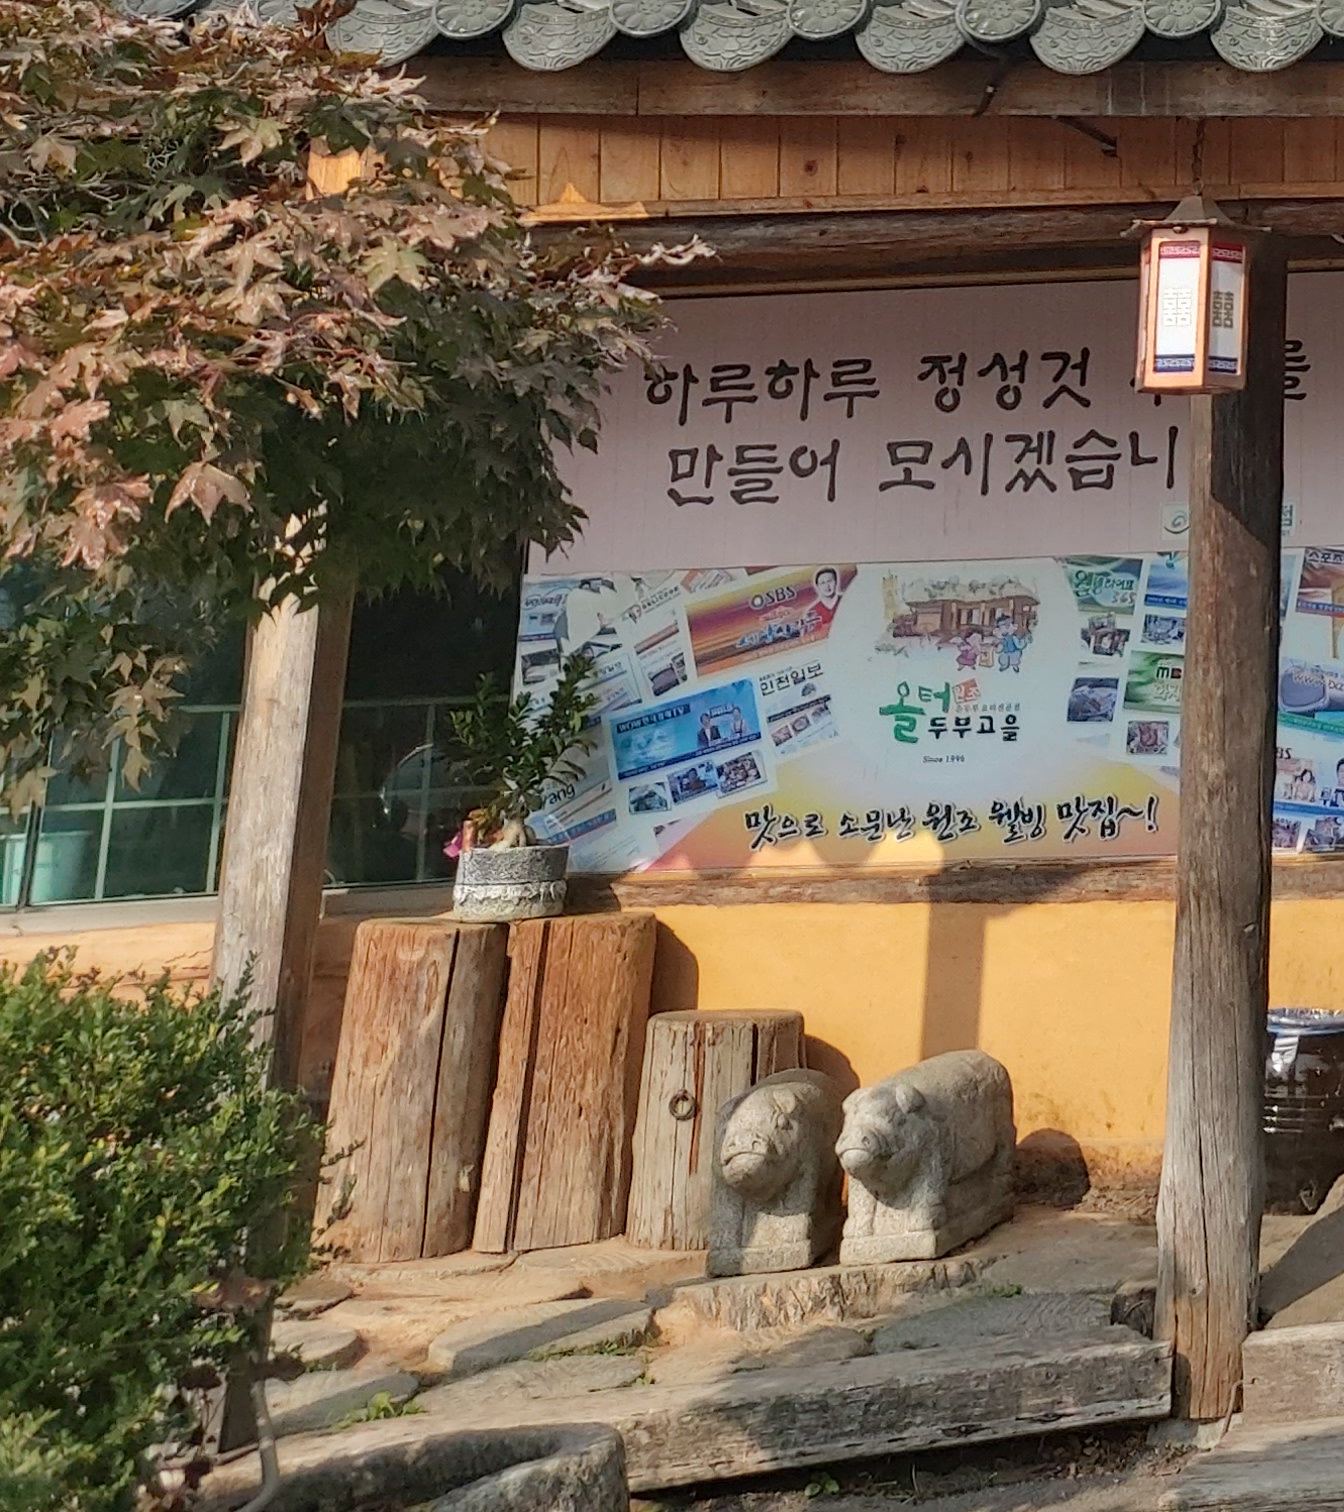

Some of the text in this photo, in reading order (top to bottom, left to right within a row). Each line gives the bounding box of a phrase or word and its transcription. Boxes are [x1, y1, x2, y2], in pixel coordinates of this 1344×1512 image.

[644, 357, 880, 426] 하루하루
[667, 425, 1179, 507] 만들어 모시겠습니
[928, 713, 1021, 743] 두부고을
[744, 804, 827, 850] 맛으로
[838, 806, 915, 841] 소문난
[921, 801, 978, 841] 원조
[988, 796, 1044, 844] 웰빙
